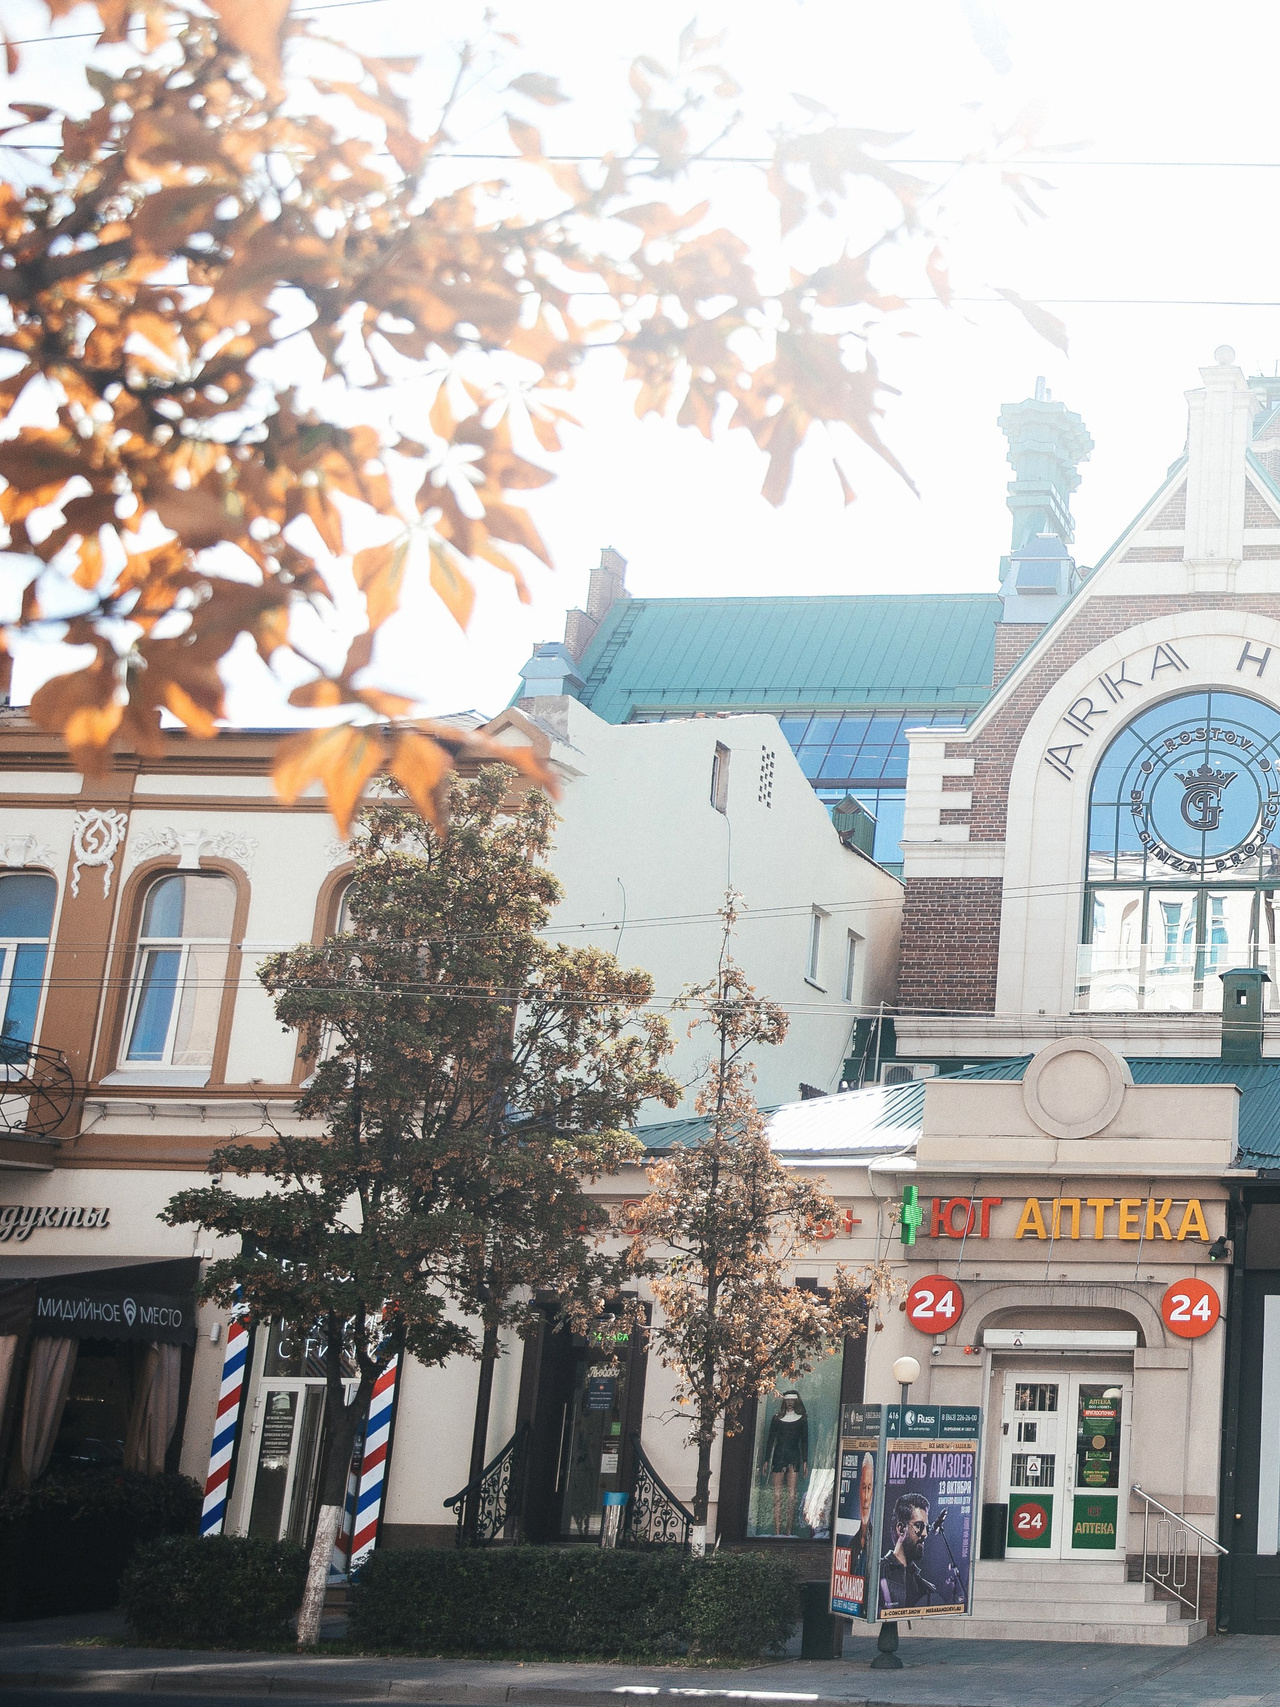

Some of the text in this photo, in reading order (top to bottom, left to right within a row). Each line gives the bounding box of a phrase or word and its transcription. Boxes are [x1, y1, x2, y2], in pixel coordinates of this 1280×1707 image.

[1163, 727, 1254, 752] ROSTOV
[1130, 789, 1280, 875] BY GINZA PROJECT
[930, 1197, 1210, 1242] ЮГ АПТЕКА
[37, 1297, 183, 1328] МИДИЙНОЕ МЕСТО
[912, 1290, 956, 1318] 24
[1169, 1294, 1212, 1321] 24
[917, 1414, 935, 1424] Russ
[889, 1453, 973, 1479] МЕРАБ АМЗОЕВ
[938, 1481, 972, 1495] 13 ОКТЯБРЯ
[1018, 1512, 1043, 1529] 24
[1088, 1505, 1103, 1517] ЮГ
[1074, 1522, 1114, 1535] АПТЕКА
[836, 1548, 851, 1572] ОЛЕГ
[834, 1574, 864, 1602] ГАЗМАНОВ
